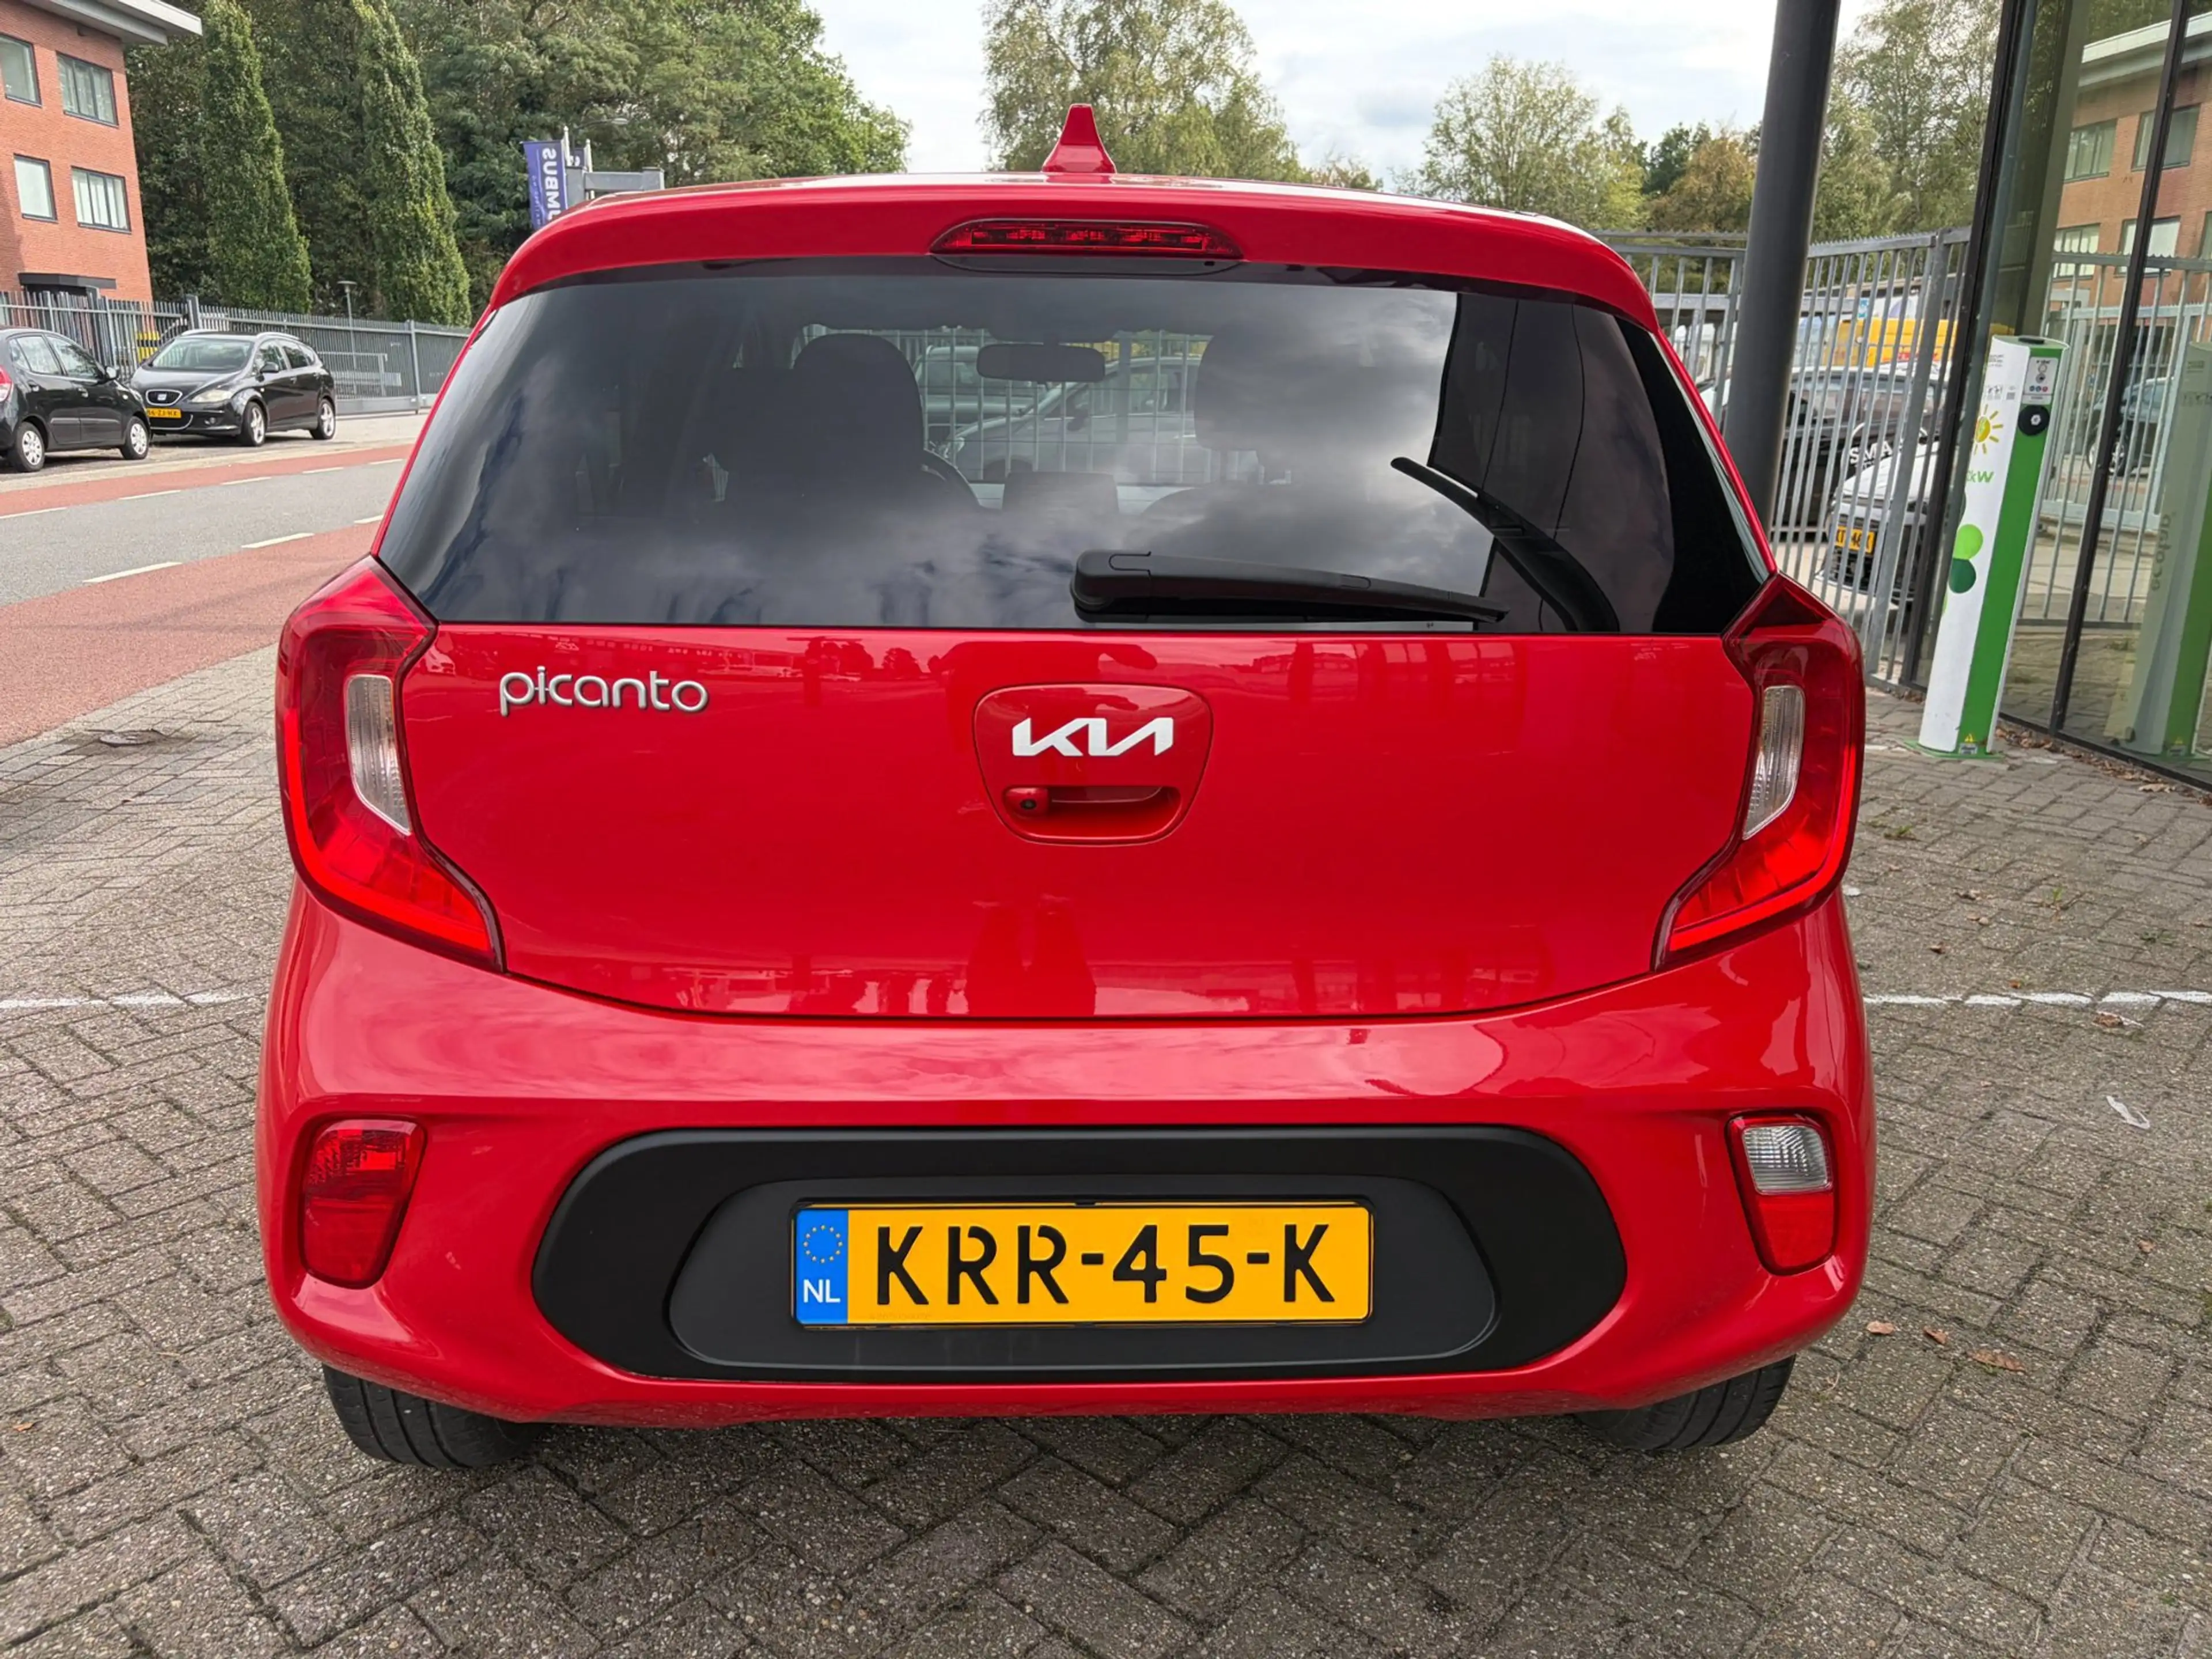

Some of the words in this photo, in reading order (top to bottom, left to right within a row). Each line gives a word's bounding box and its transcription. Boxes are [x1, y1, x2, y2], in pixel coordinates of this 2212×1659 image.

[499, 665, 709, 717] picanto
[1012, 717, 1174, 756] KIA
[876, 1224, 1336, 1305] KRR-45-K
[803, 1278, 841, 1304] NL
